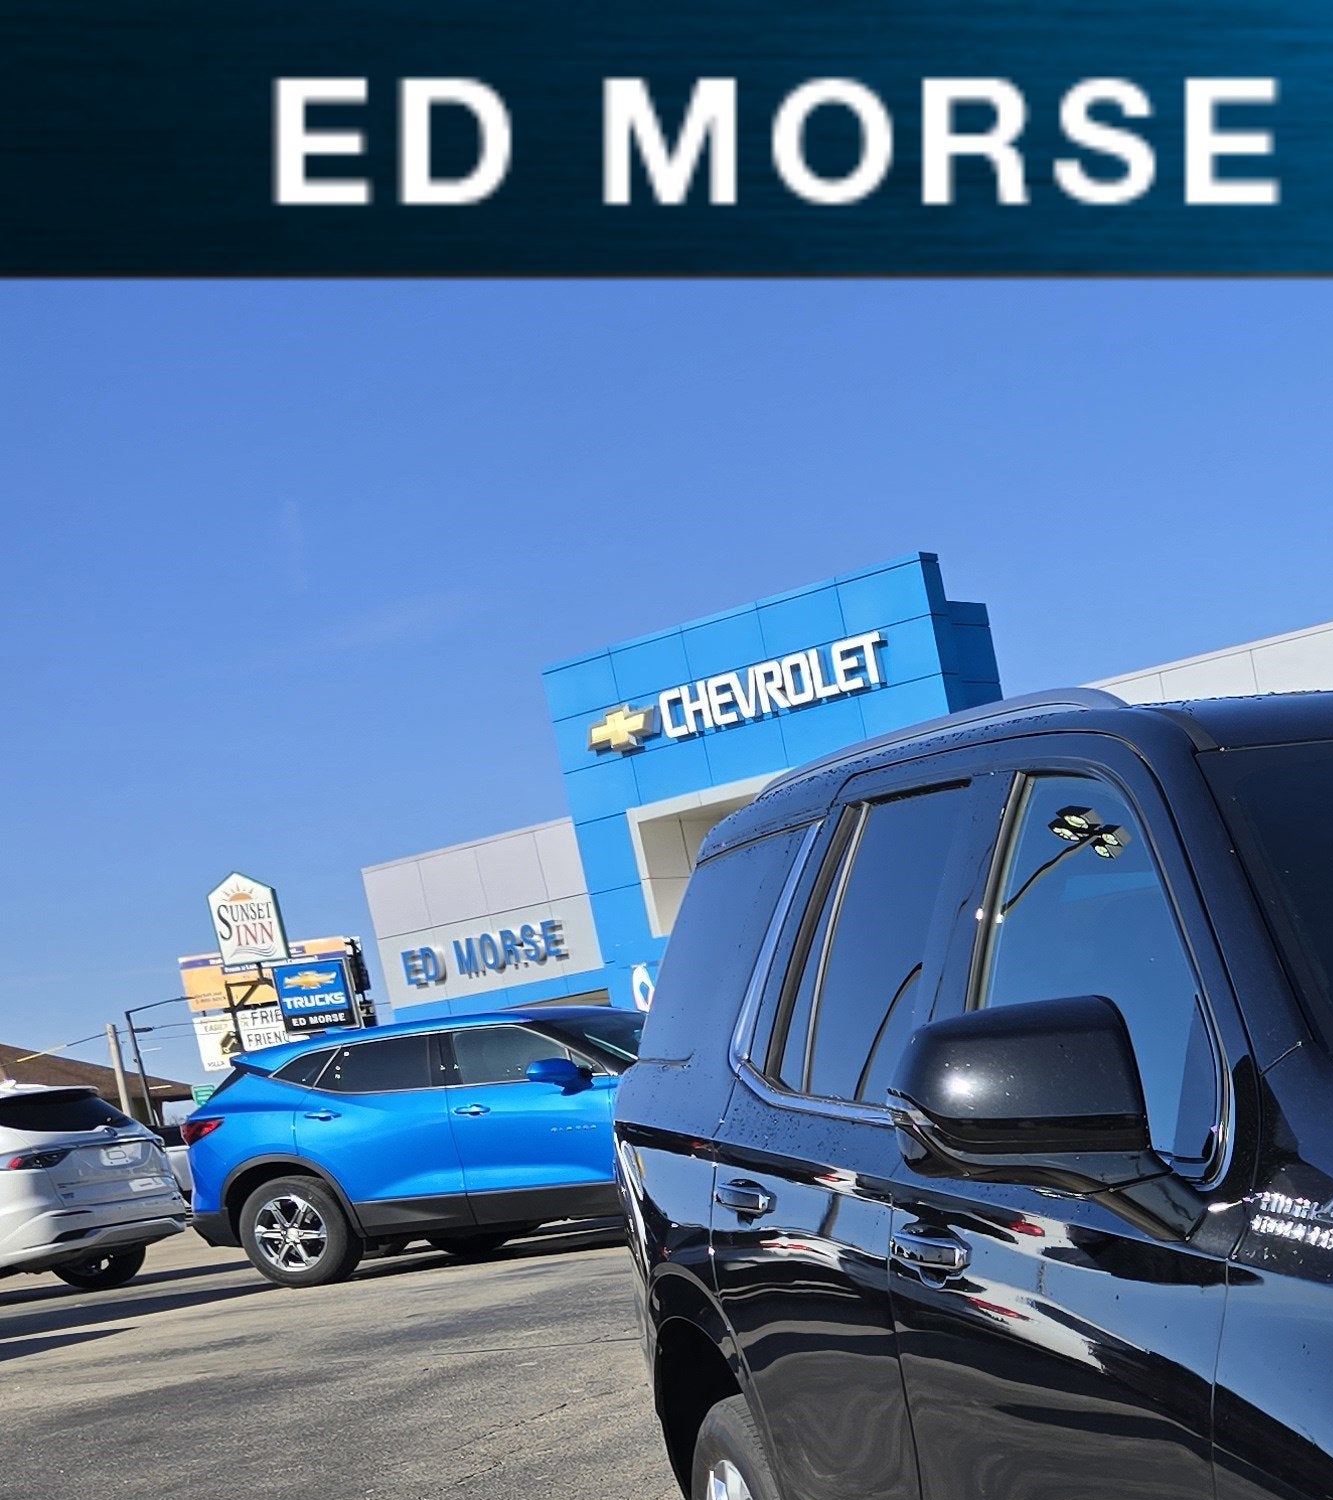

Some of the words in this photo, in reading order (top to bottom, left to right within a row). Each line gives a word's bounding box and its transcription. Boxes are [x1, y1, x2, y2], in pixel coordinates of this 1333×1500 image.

[658, 630, 884, 739] CHEVROLET
[236, 921, 274, 947] INN
[400, 946, 442, 986] ED
[452, 919, 565, 976] MORSE
[282, 991, 346, 1010] TRUCKS
[250, 1008, 284, 1027] FRIE
[291, 1017, 307, 1027] ED
[308, 1012, 346, 1025] MORSE
